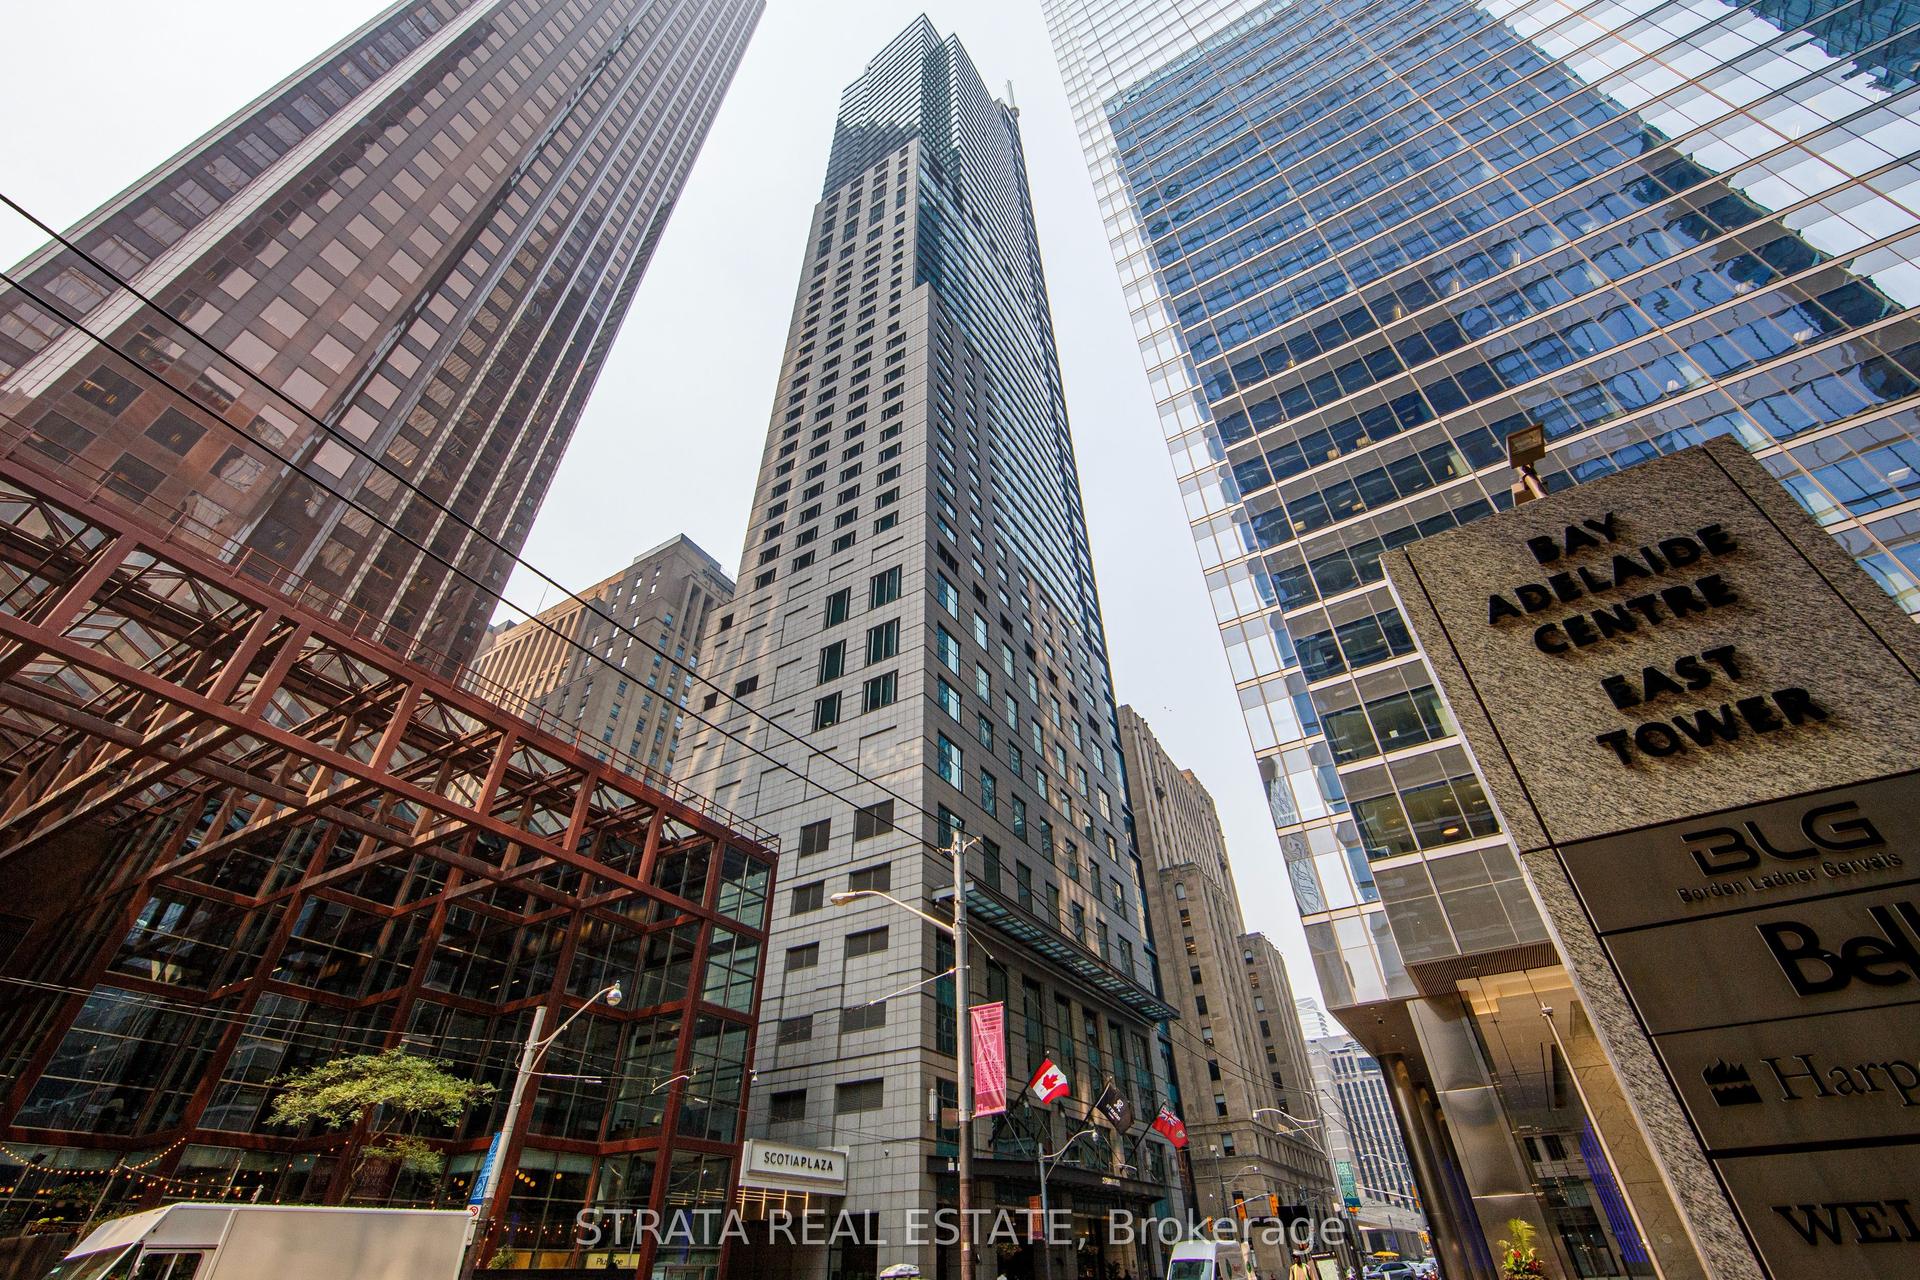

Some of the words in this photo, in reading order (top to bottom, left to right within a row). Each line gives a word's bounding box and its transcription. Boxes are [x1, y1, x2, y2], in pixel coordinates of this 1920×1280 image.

[1526, 512, 1616, 564] BAY
[1488, 524, 1738, 625] ADELAIDE
[1533, 573, 1738, 655] CENTRE
[1600, 645, 1748, 710] EAST
[1596, 687, 1828, 766] TOWER
[1680, 800, 1886, 878] BLG
[1676, 879, 1747, 904] Borden
[1747, 865, 1817, 892] Ladner
[1821, 851, 1903, 879] Gervais
[764, 1151, 833, 1171] SCOTIAPLAZA
